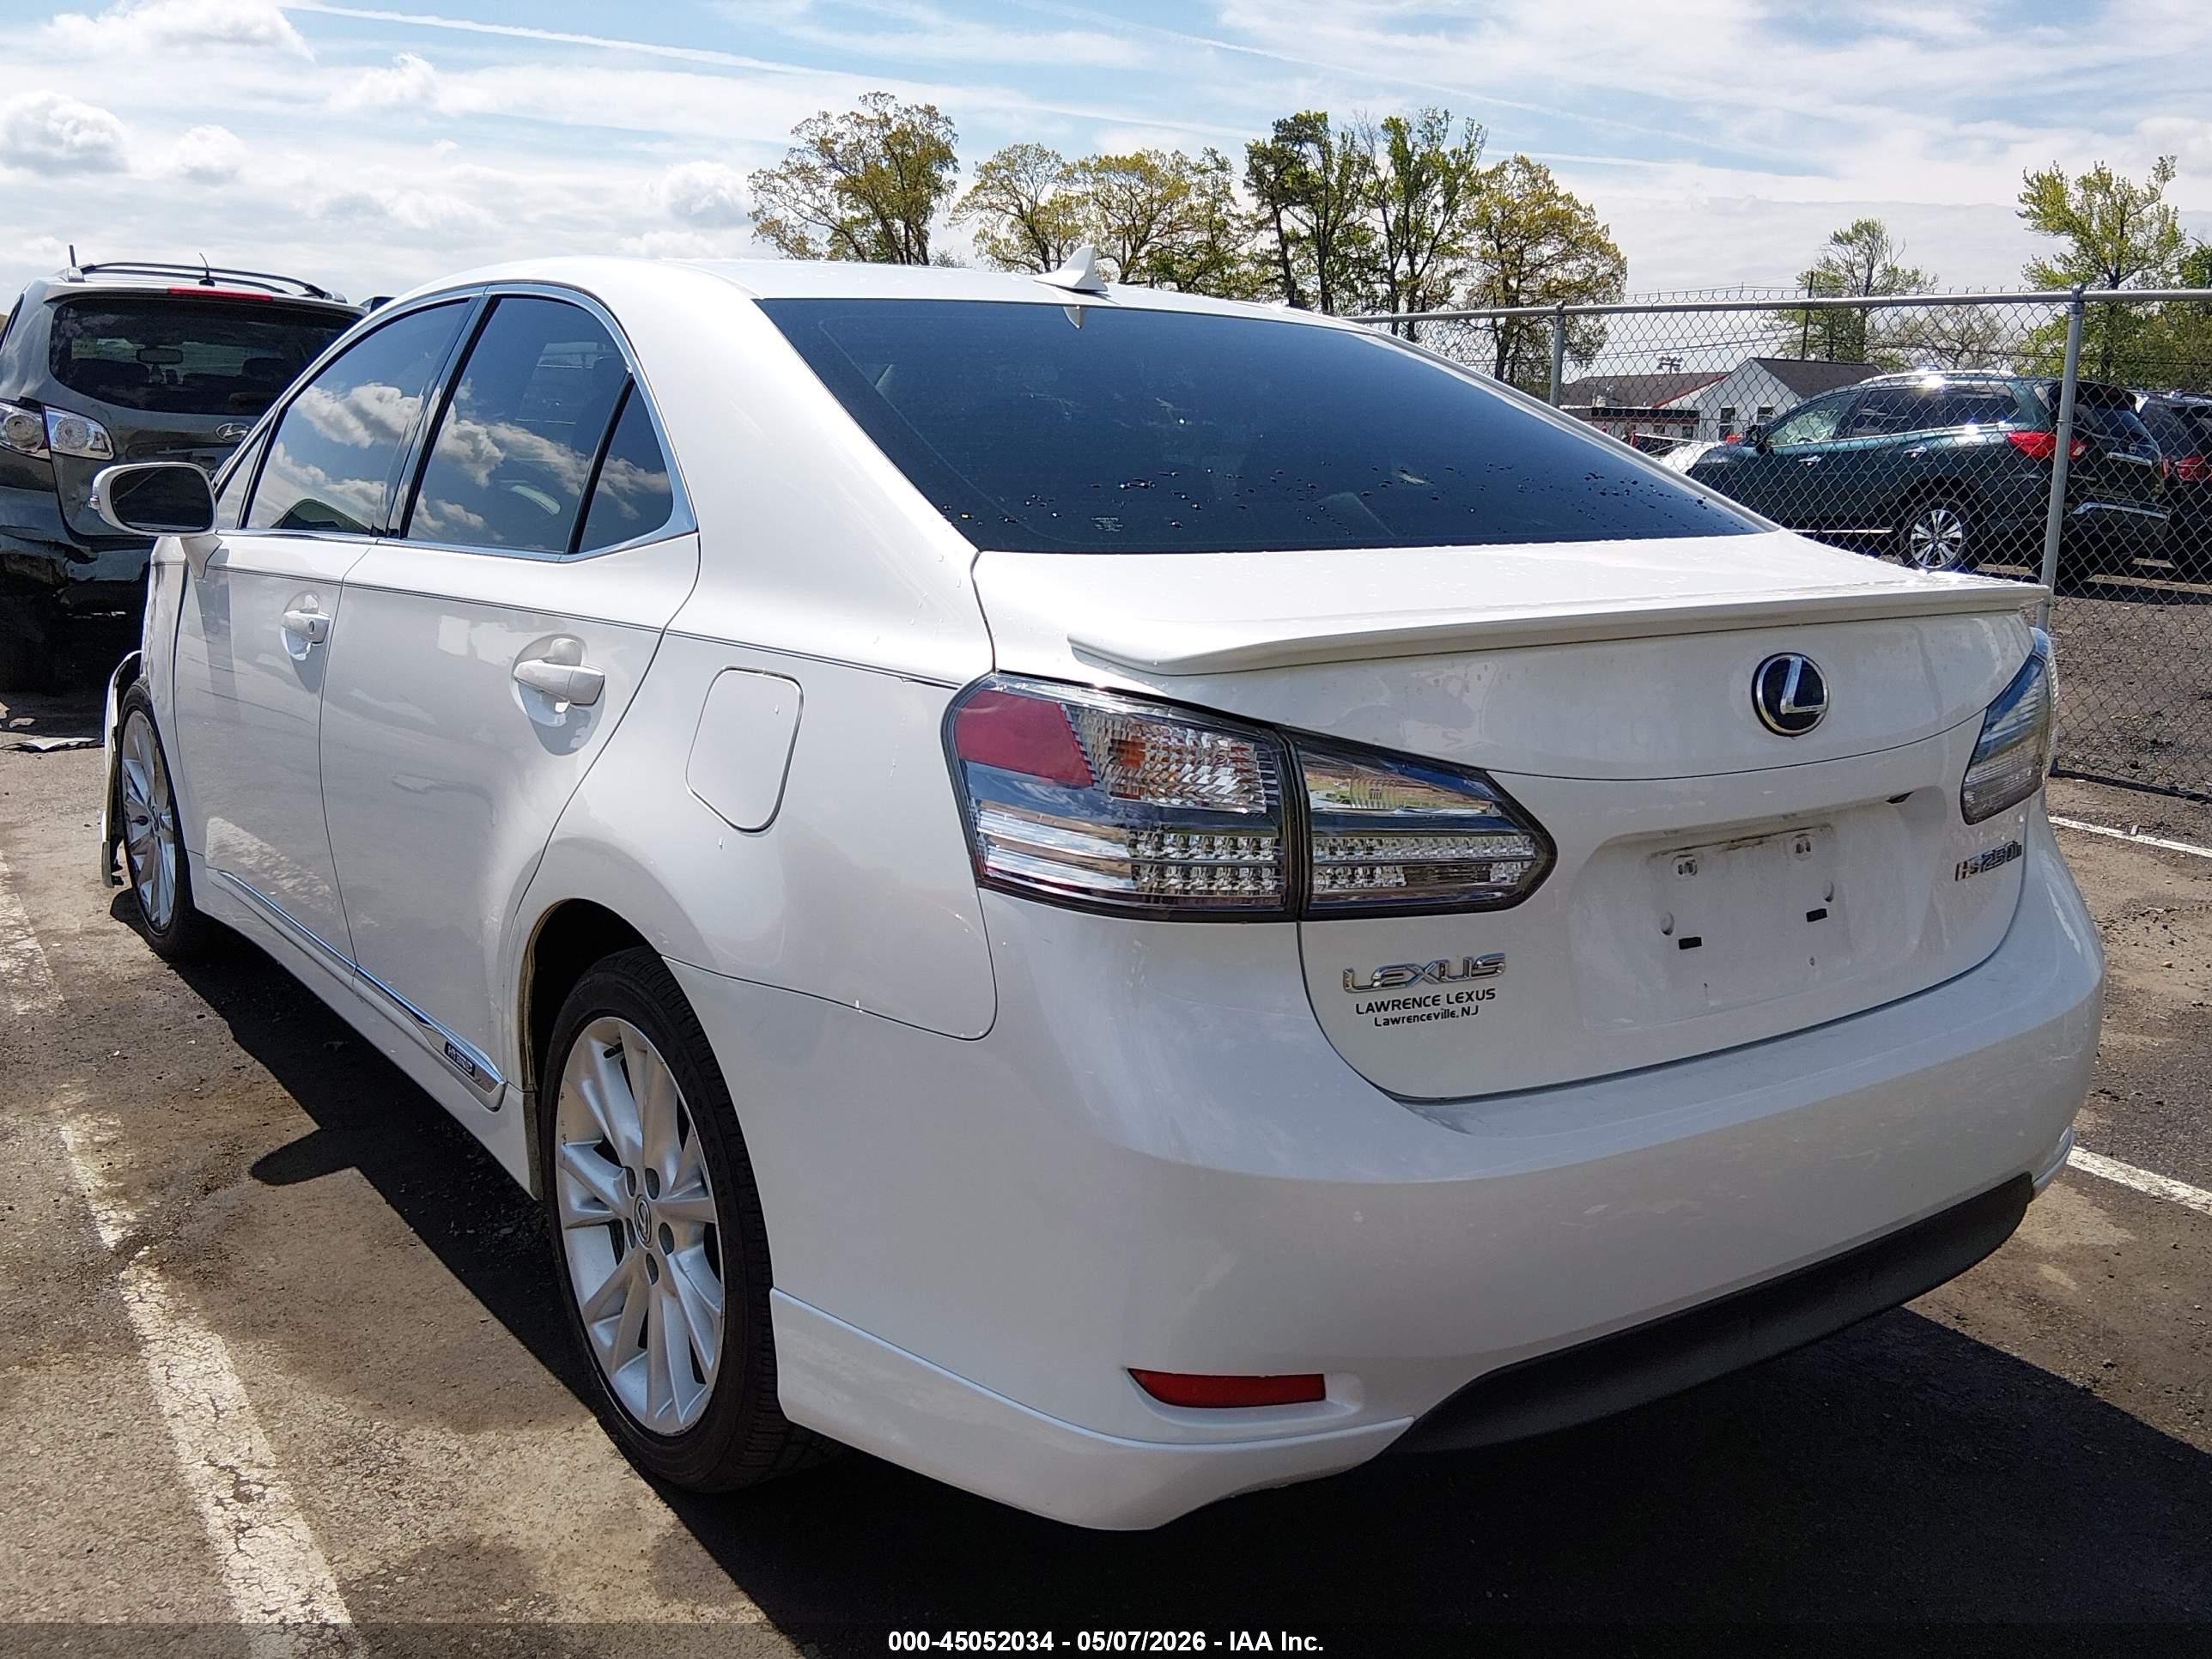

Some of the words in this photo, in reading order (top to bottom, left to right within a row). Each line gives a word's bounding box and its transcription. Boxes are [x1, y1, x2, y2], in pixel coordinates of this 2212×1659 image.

[1342, 952, 1505, 994] LEXUS
[1355, 994, 1441, 1015] LAWRENCE
[1446, 988, 1496, 1005] LEXUS
[1461, 1005, 1479, 1017] NJ
